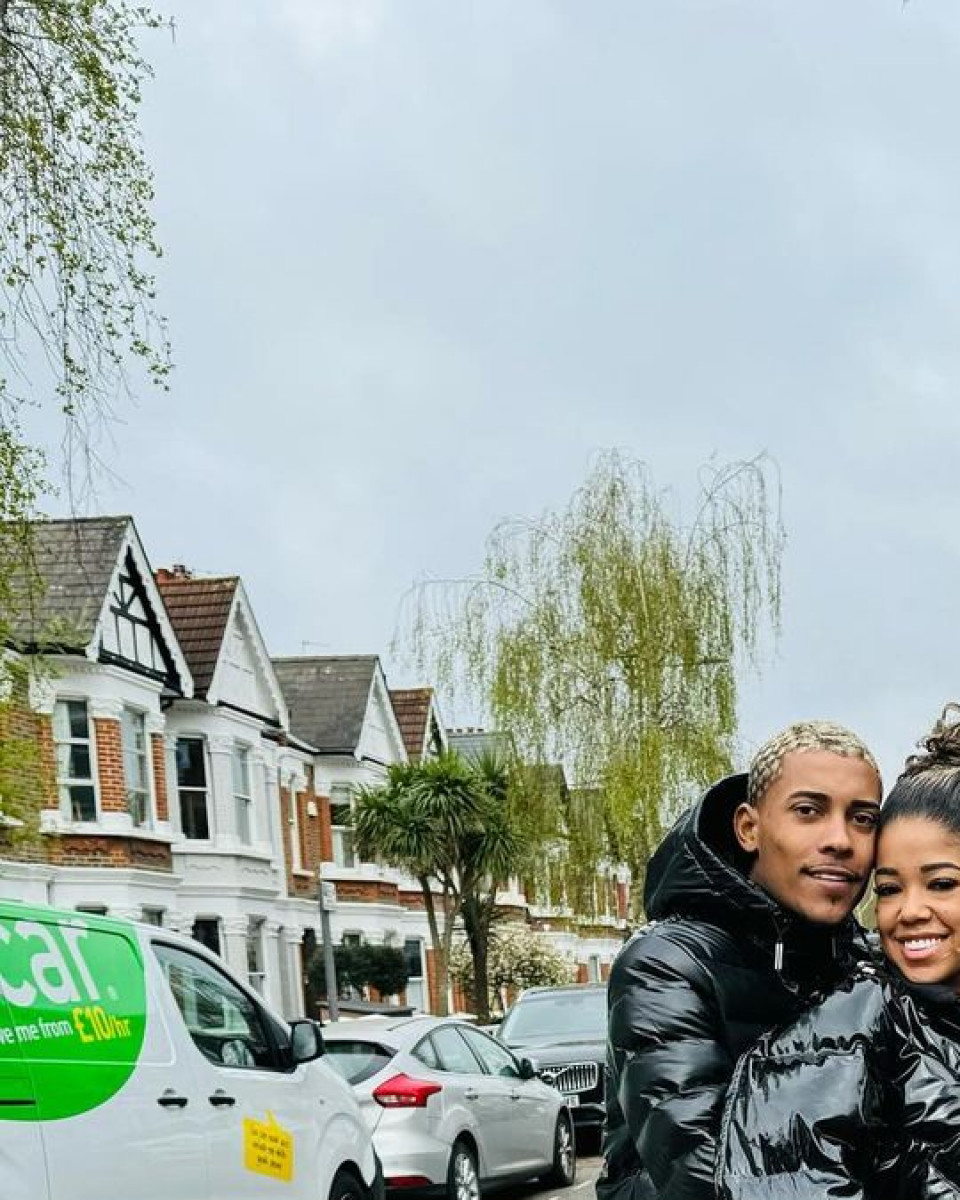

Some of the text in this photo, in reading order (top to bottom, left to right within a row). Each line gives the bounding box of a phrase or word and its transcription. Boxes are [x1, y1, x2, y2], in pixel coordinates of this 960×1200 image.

[15, 1023, 40, 1043] me
[39, 1016, 73, 1039] from
[72, 1005, 131, 1042] £10/hr
